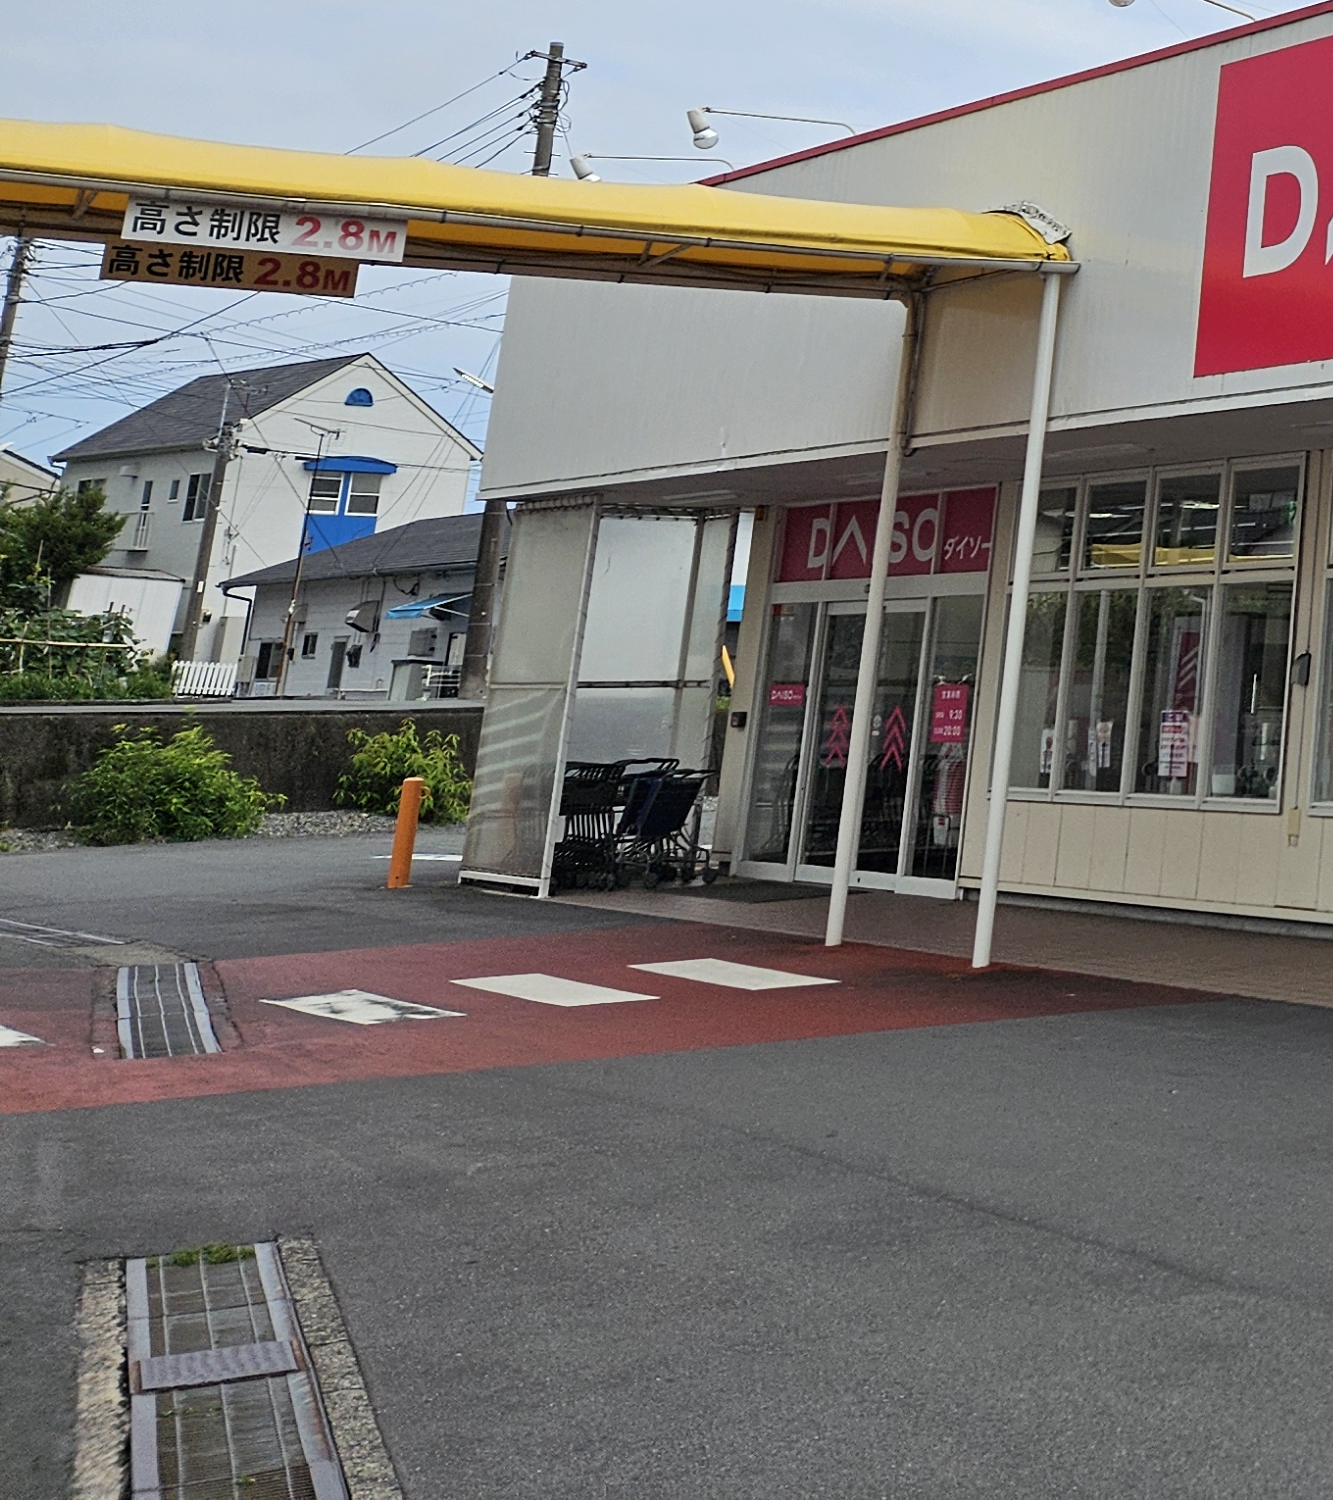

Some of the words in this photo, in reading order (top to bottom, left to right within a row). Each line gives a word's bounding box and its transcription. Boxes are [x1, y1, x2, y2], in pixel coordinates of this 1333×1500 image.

[132, 202, 281, 244] 高さ制限
[291, 216, 397, 254] 2.8M
[108, 245, 244, 283] 高さ制限
[254, 257, 350, 291] 2.8M
[807, 508, 938, 569] DASO
[943, 535, 992, 560] ダイソー
